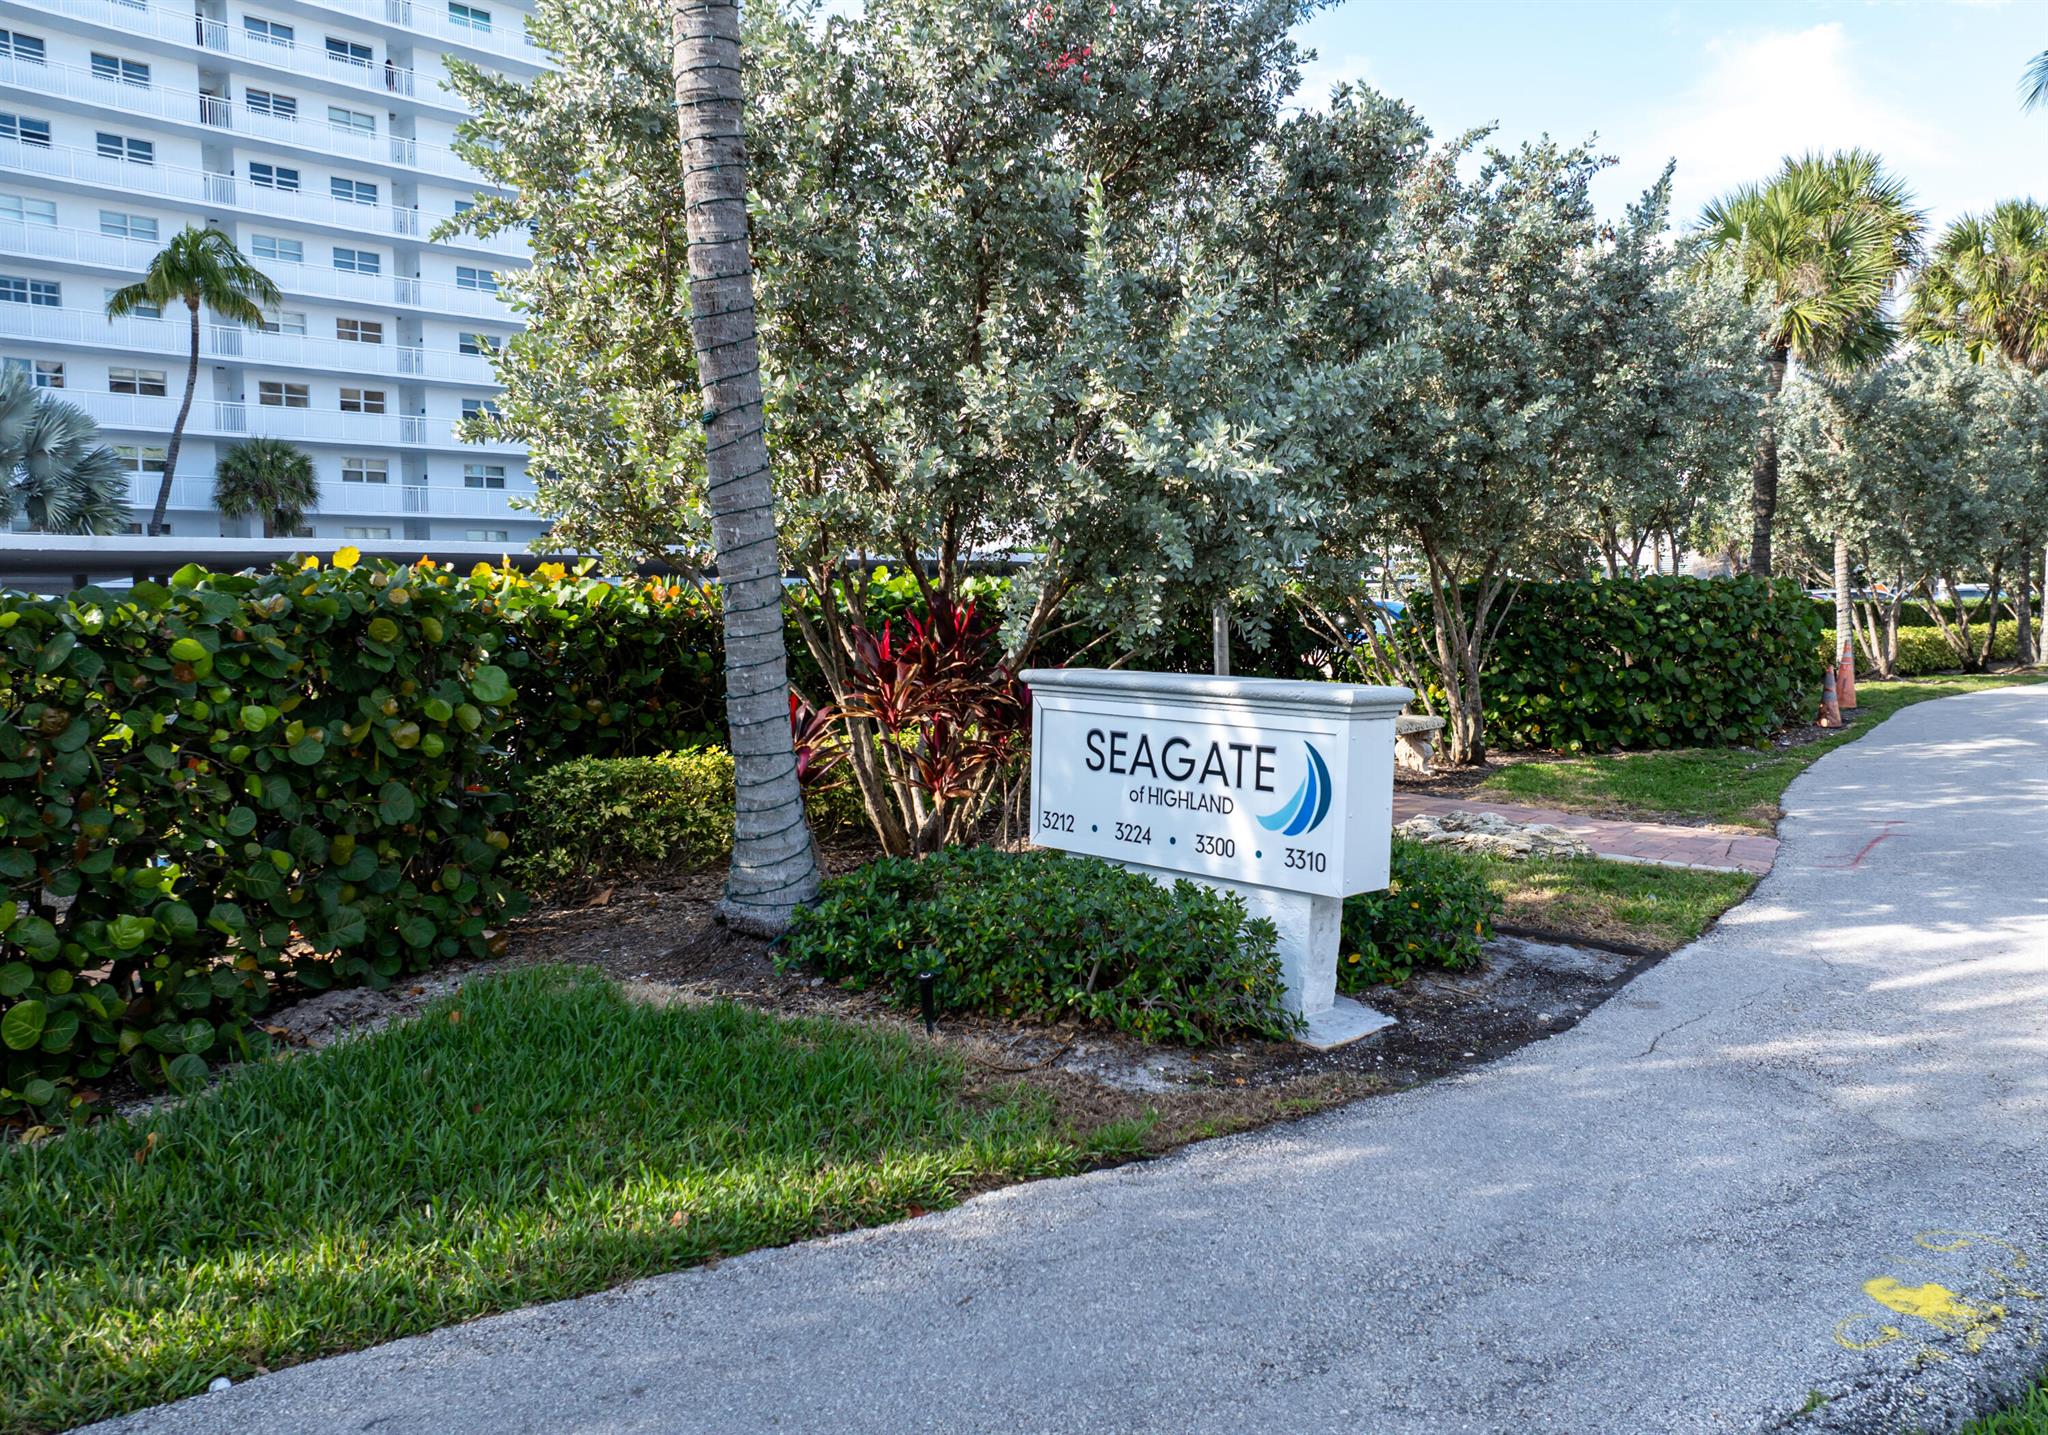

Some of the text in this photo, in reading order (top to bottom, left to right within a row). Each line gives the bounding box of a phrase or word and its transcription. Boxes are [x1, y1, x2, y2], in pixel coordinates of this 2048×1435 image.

[1085, 728, 1277, 793] SEAGATE
[1129, 785, 1234, 815] of HIGHLAND
[1042, 811, 1327, 873] 3212 3224 3300 3310
